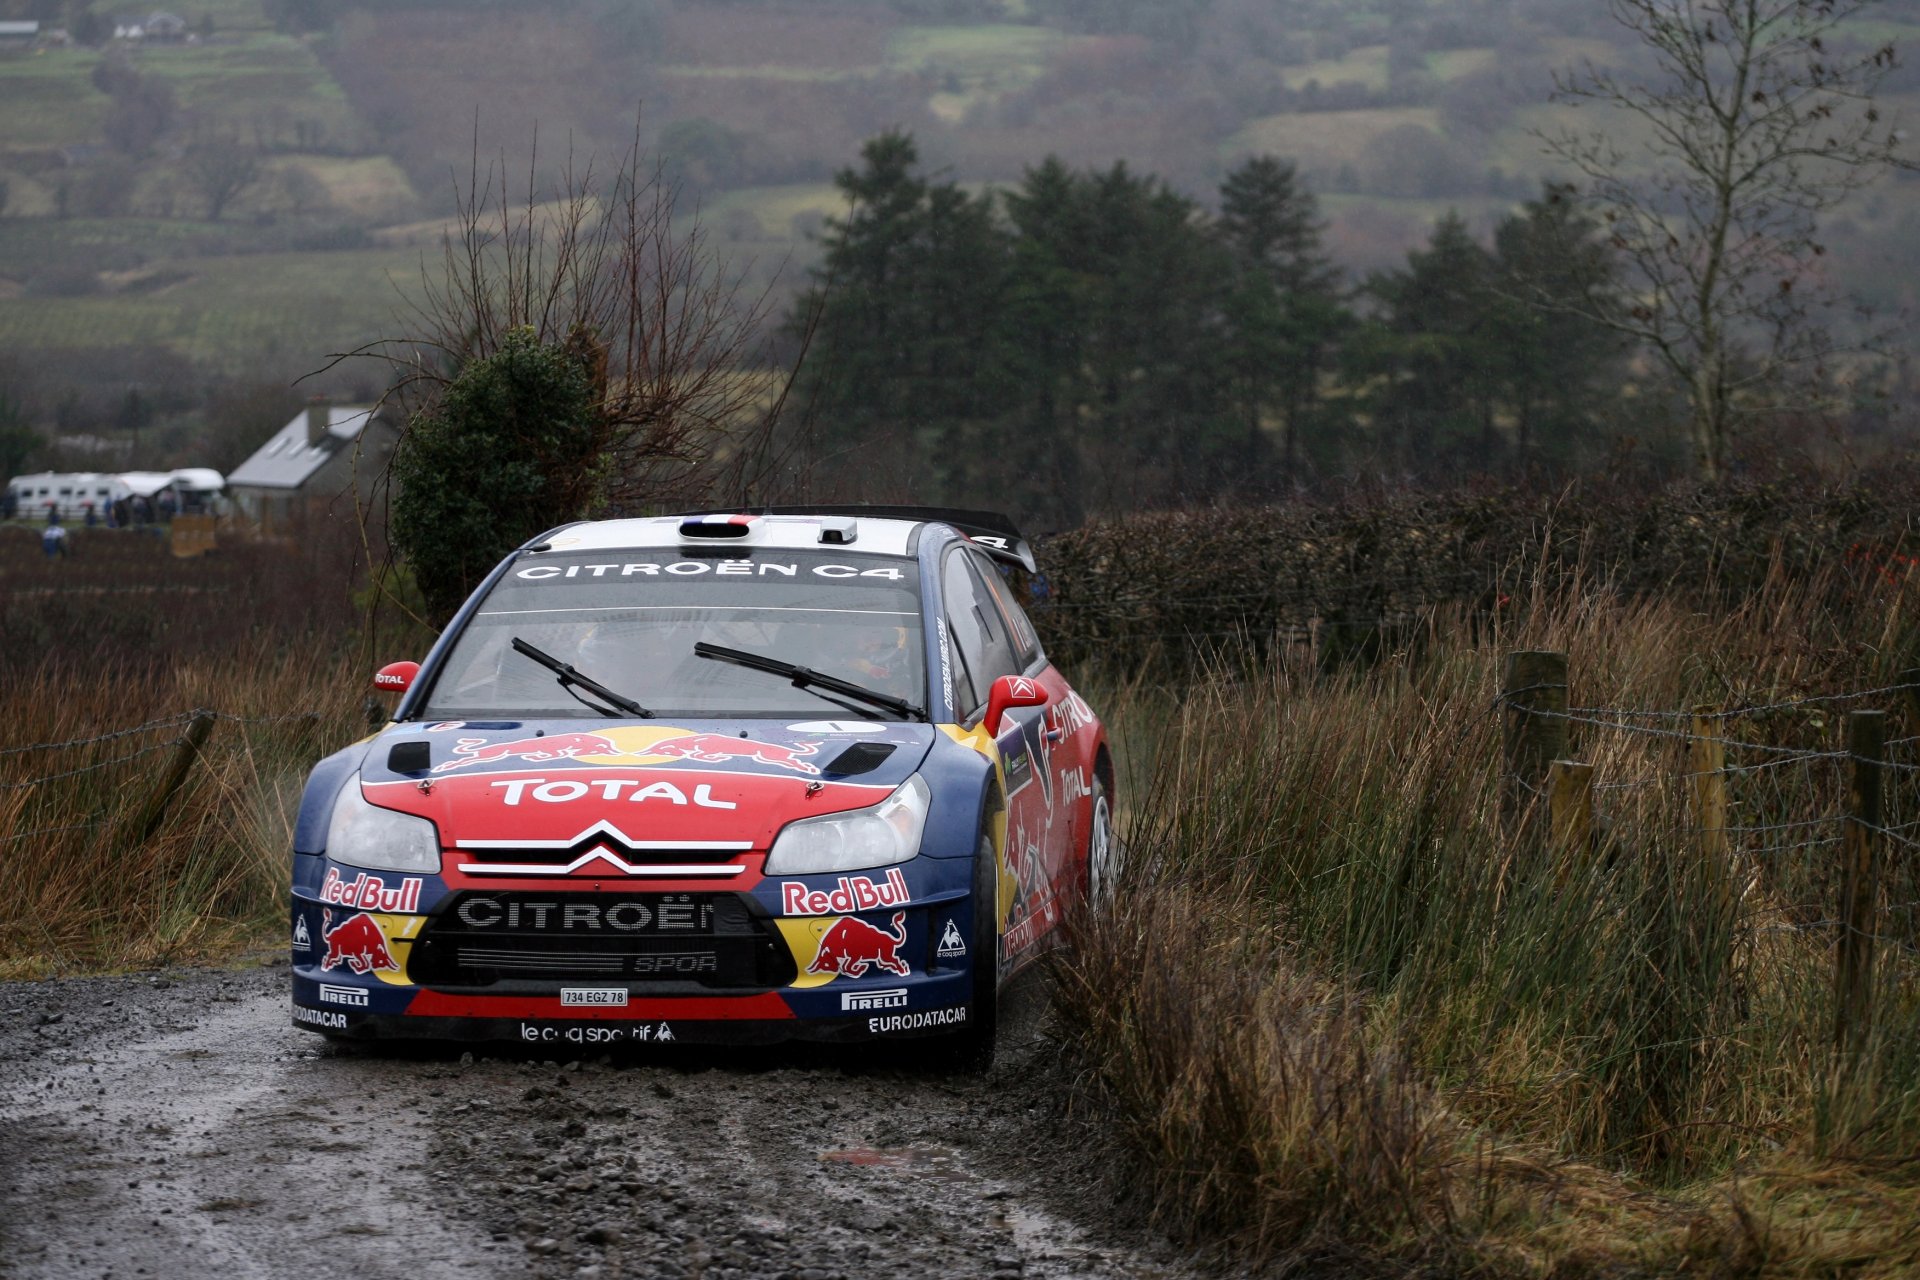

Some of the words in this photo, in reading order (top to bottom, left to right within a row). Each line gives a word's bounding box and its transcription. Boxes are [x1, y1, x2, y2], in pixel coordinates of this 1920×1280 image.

[516, 559, 798, 579] CITROËN
[811, 564, 905, 580] C4
[375, 673, 405, 684] TOTAL
[491, 778, 737, 810] TOTAL
[1061, 765, 1092, 807] TOTAL
[319, 867, 366, 907] Red
[357, 876, 423, 912] Bull
[782, 877, 855, 916] Red
[850, 867, 911, 911] Bull
[319, 983, 369, 1006] PIRELLI
[565, 992, 583, 1003] 734
[587, 992, 608, 1003] EGZ
[611, 992, 624, 1003] 78
[841, 988, 908, 1011] PIRELLI
[293, 1004, 347, 1028] ODATACAR
[869, 1007, 966, 1033] EURODATACAR
[521, 1022, 539, 1041] le
